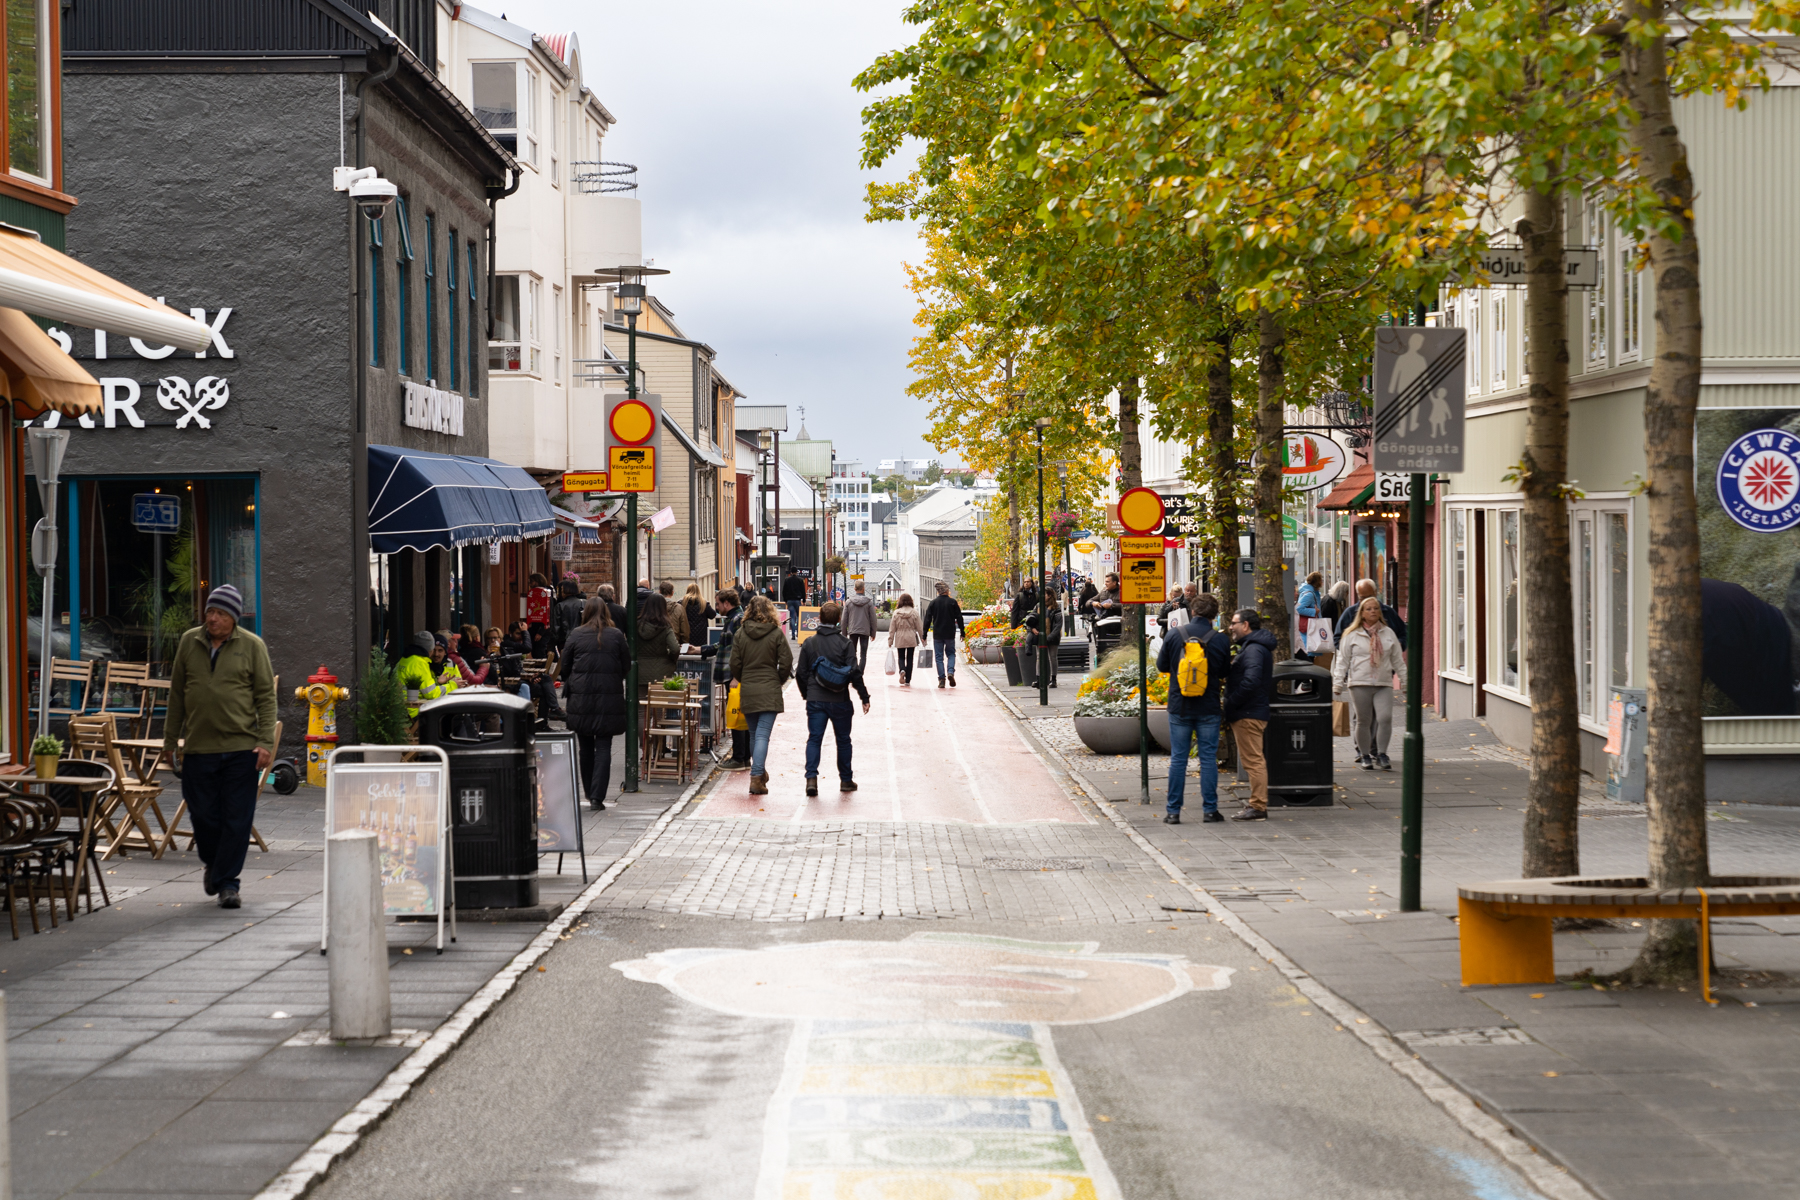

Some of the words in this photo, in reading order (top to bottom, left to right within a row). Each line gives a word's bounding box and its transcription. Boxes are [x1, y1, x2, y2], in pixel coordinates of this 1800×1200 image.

[1378, 442, 1459, 455] Göngugata
[1722, 433, 1800, 479] ICEWEA
[1397, 457, 1440, 468] endar
[566, 478, 605, 487] Göngugata
[1379, 478, 1412, 498] SAG
[1179, 524, 1200, 533] INFO
[1122, 541, 1162, 550] Göngugata
